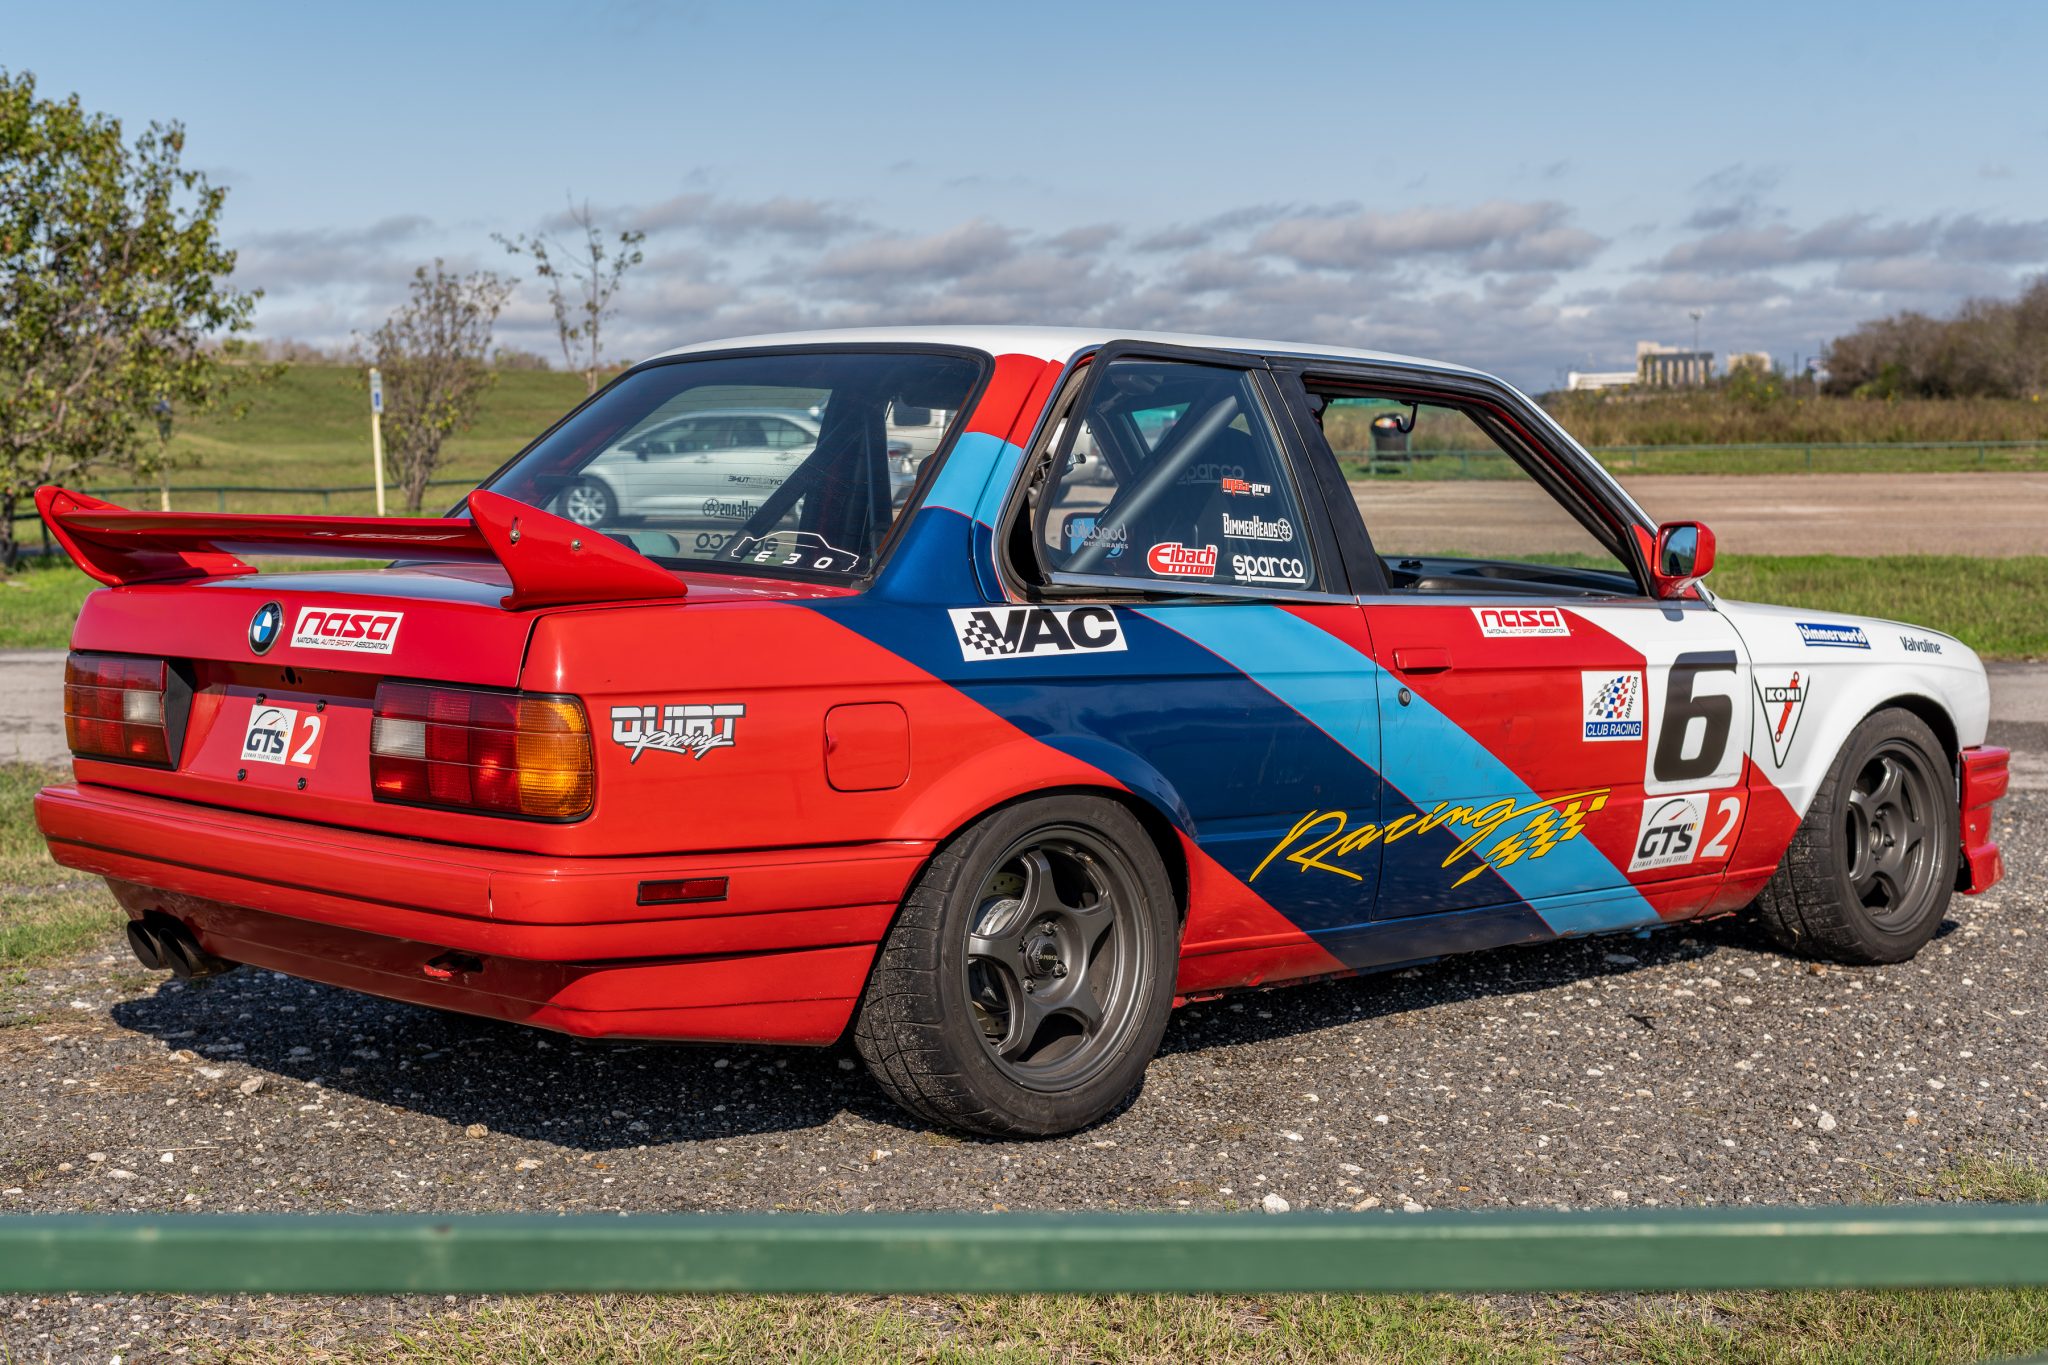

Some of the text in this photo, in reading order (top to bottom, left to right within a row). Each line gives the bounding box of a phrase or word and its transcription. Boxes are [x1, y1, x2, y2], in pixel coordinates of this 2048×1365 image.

[1148, 542, 1217, 574] Eibach
[1232, 554, 1305, 582] sparco
[295, 636, 390, 650] NATIONAL AUTO SPORT ASSOCIATION
[965, 606, 1118, 655] VAC
[1798, 625, 1867, 644] bimmerworld
[1900, 636, 1943, 655] Valvoline
[1766, 688, 1800, 702] KONI
[1586, 722, 1641, 736] CLUB RACING
[1653, 650, 1738, 782] 6
[246, 727, 285, 755] GTS
[290, 715, 321, 765] 2
[624, 730, 734, 764] Racing
[1249, 788, 1611, 884] Racing
[1637, 823, 1694, 860] GTS
[1699, 796, 1741, 858] 2
